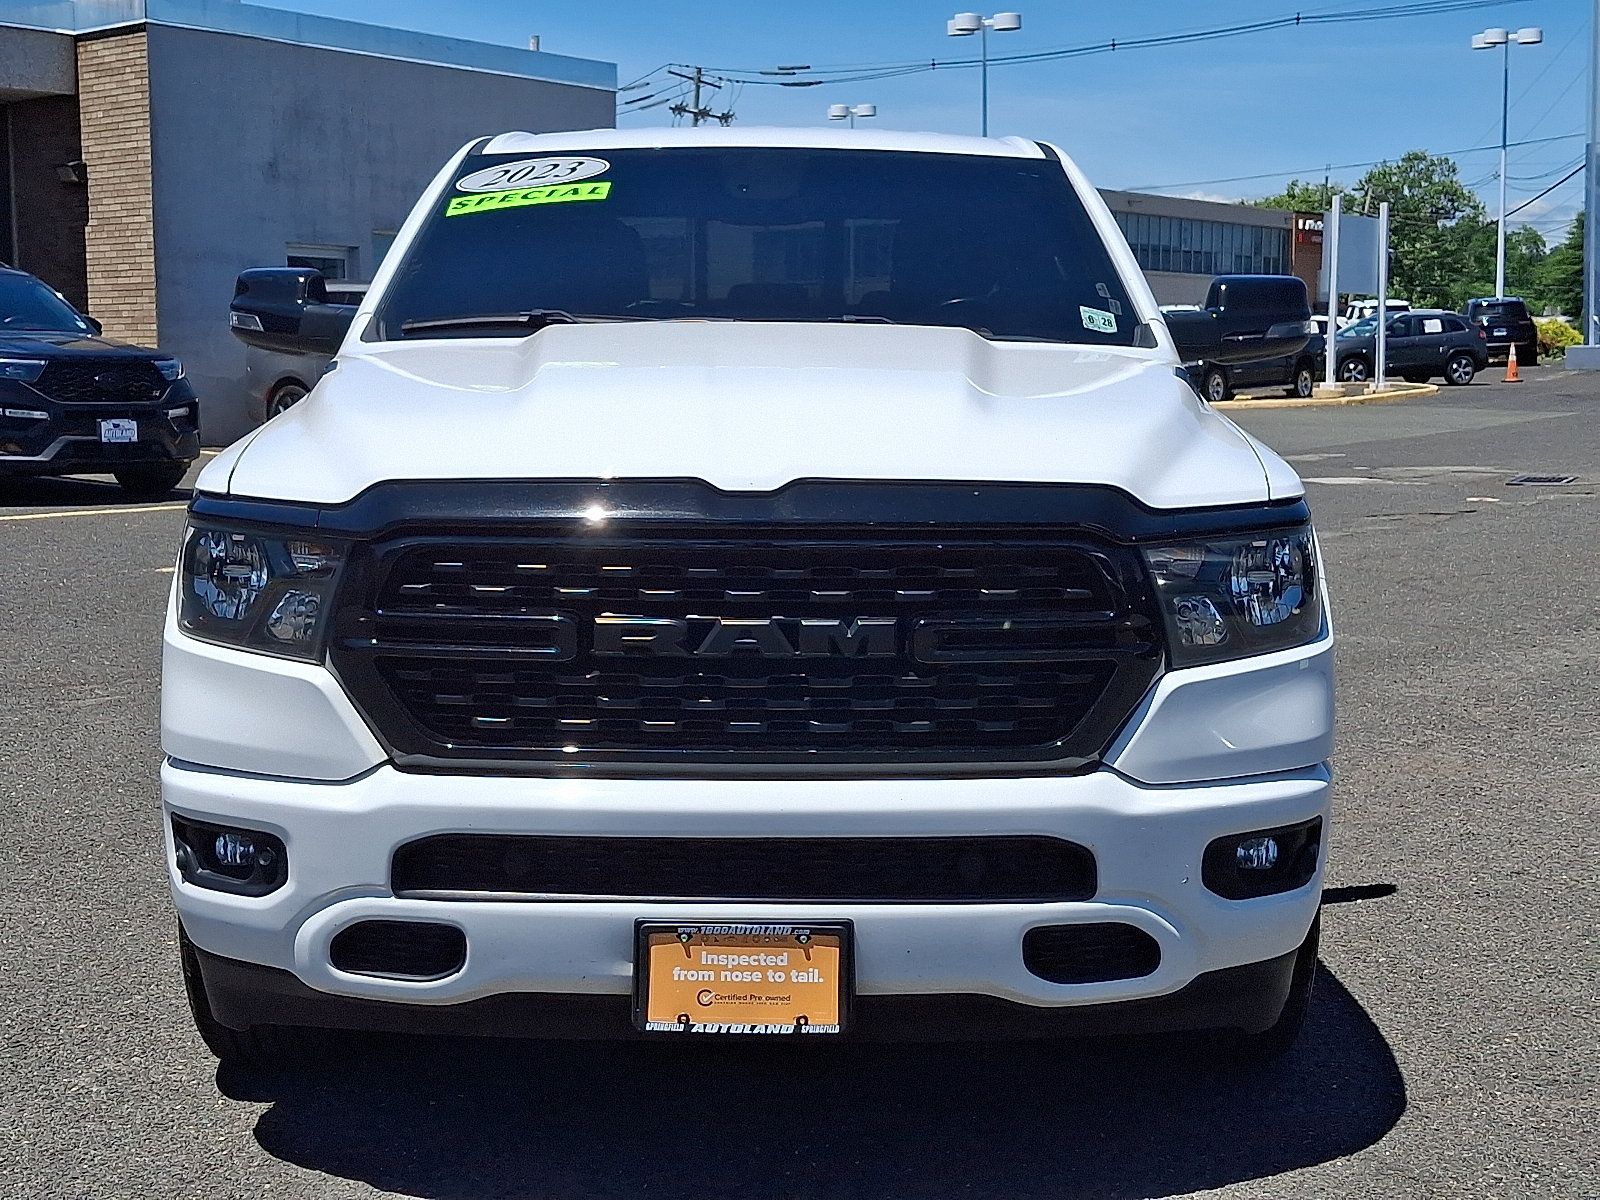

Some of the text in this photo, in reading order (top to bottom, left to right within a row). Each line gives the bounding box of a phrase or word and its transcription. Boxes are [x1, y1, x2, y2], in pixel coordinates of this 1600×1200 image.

[479, 161, 586, 188] 2023
[451, 186, 604, 210] SPECIAL
[1101, 317, 1113, 327] 28
[592, 613, 897, 657] RAM
[701, 951, 788, 968] Inspected
[672, 967, 824, 983] from nose to tail.
[714, 993, 748, 1001] Certified
[691, 1023, 795, 1034] AUTOLAND
